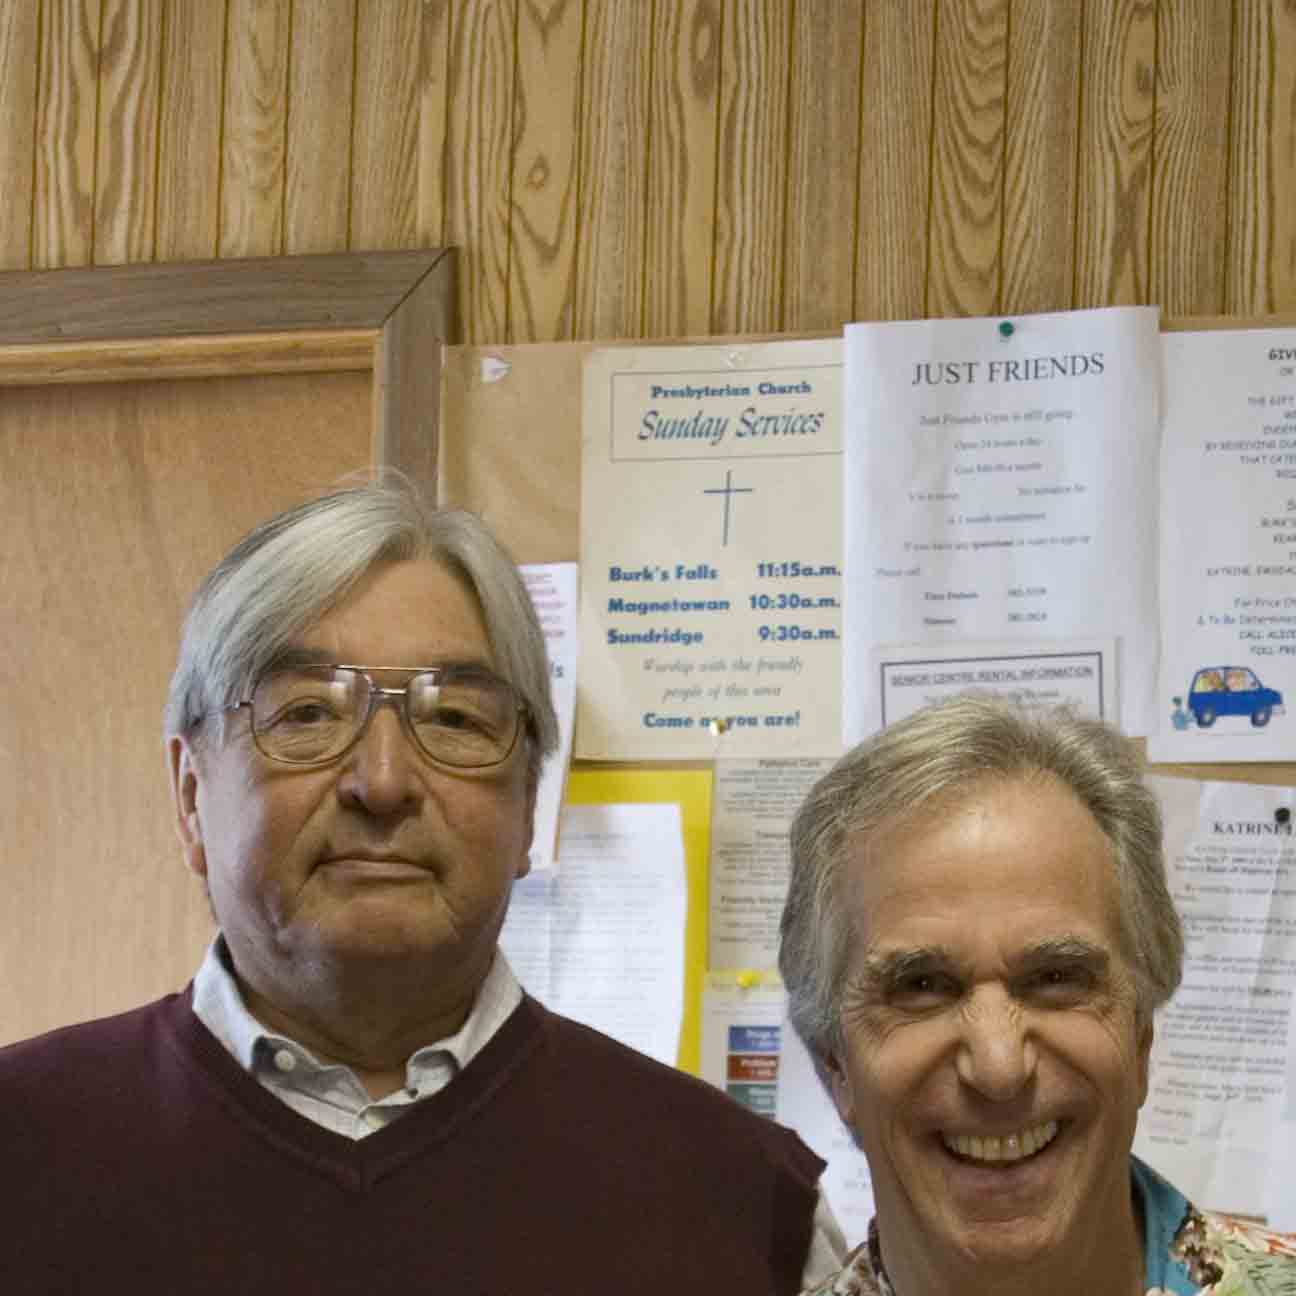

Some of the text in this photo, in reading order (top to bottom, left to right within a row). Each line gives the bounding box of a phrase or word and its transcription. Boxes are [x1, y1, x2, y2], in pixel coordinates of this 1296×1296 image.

[912, 352, 1105, 386] JUST FRIENDS
[650, 381, 812, 400] Presbyterian Church
[637, 406, 825, 446] Sunday Services
[609, 564, 719, 582] Burk's Falls
[756, 562, 842, 578] 11:15a.m.
[749, 593, 842, 610] 10:30a.m.
[608, 627, 704, 646] Sundridge
[757, 625, 841, 641] 9:30a.m.
[732, 657, 752, 672] the
[757, 656, 803, 675] friendly
[662, 683, 703, 704] people
[707, 684, 722, 702] of
[643, 712, 694, 728] Come
[725, 714, 759, 731] you
[764, 710, 801, 728] are!
[1213, 821, 1282, 837] KATRINE
